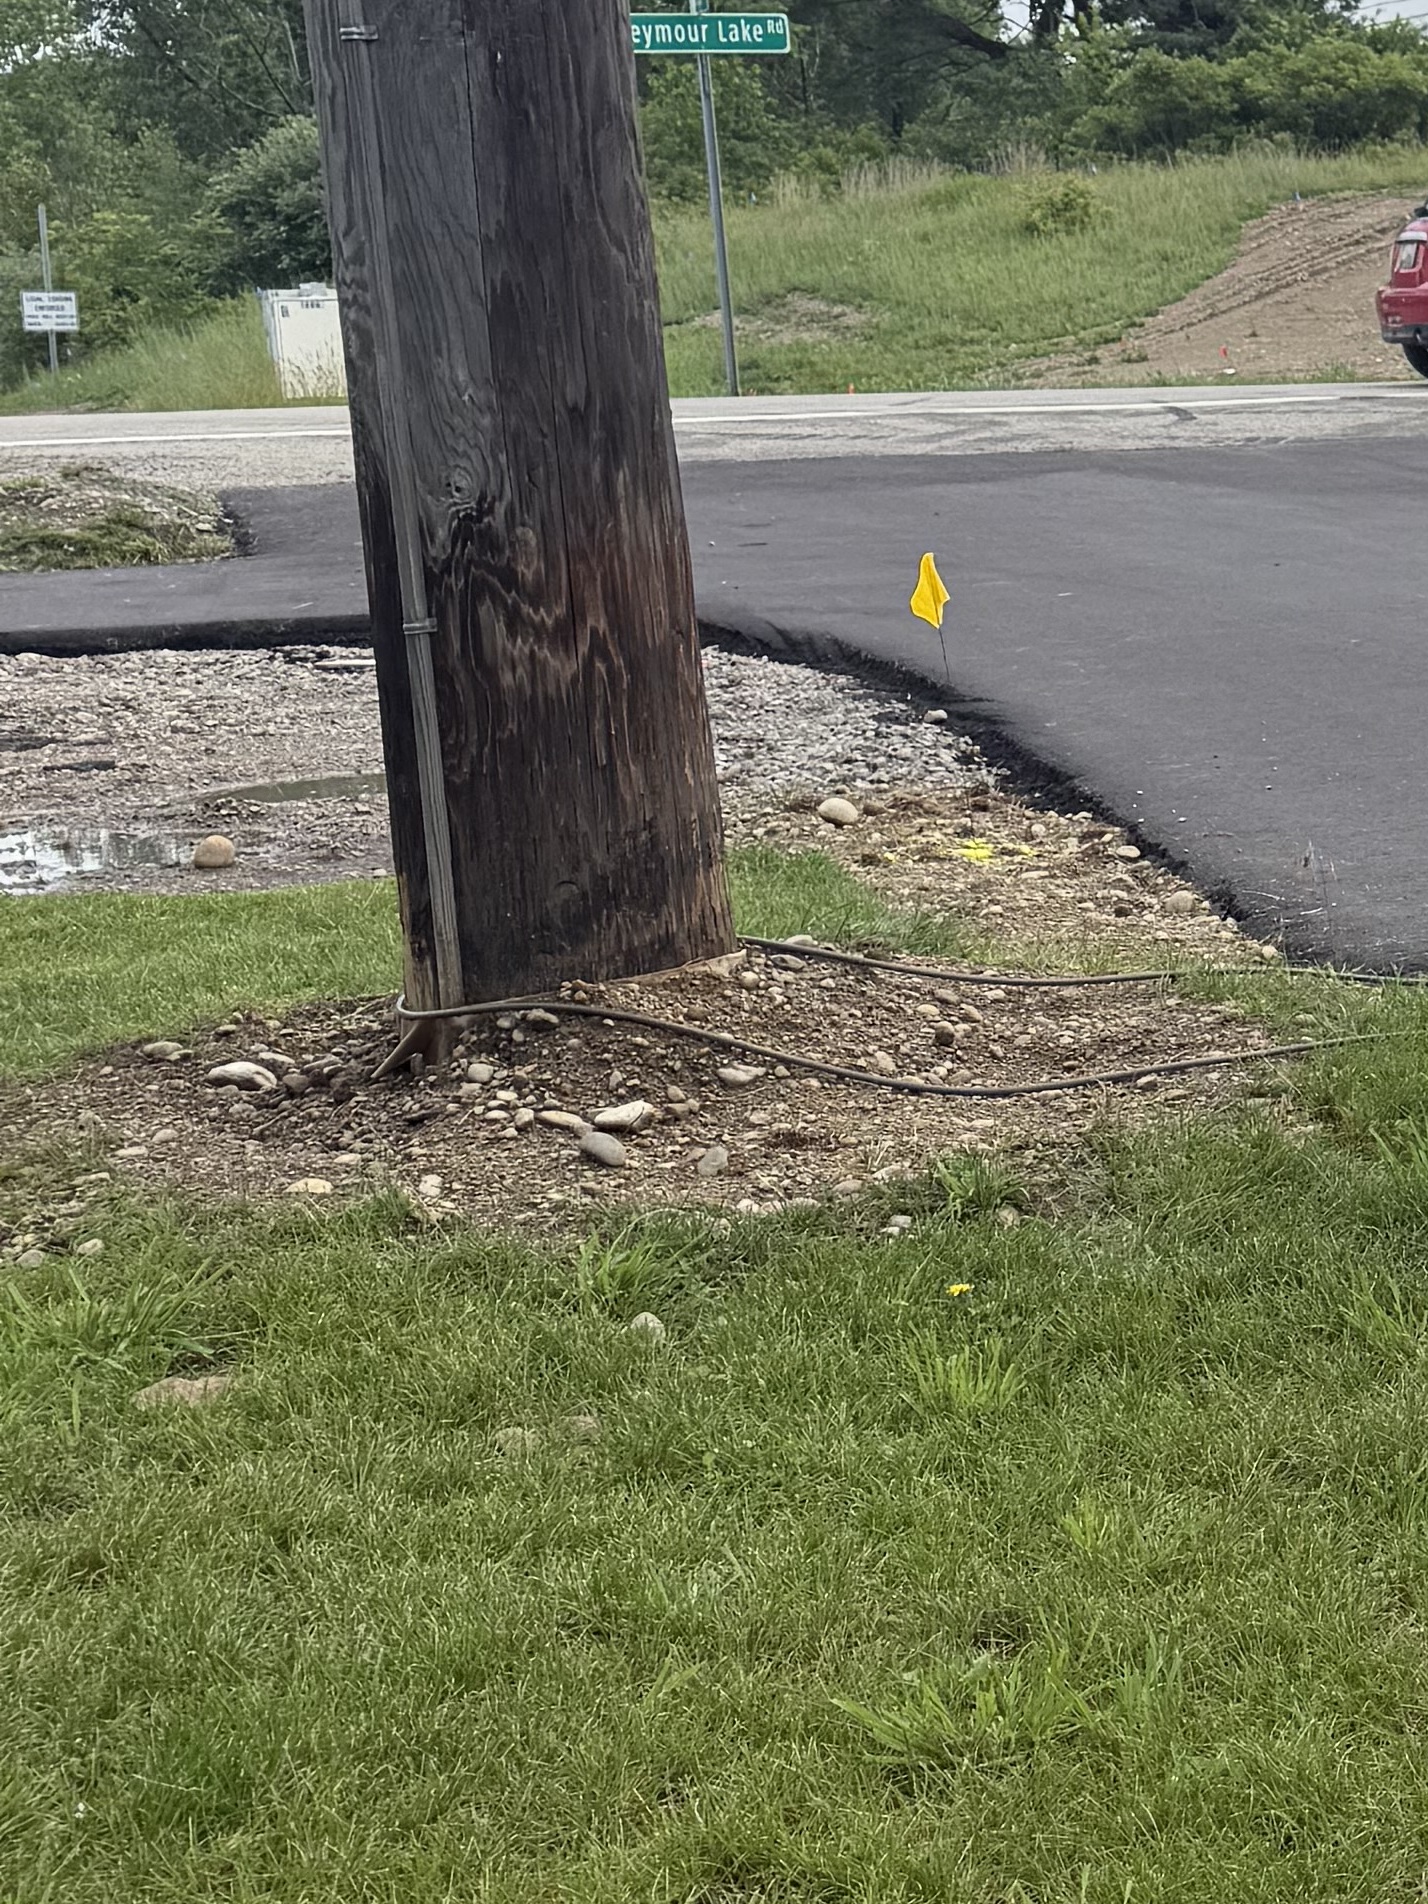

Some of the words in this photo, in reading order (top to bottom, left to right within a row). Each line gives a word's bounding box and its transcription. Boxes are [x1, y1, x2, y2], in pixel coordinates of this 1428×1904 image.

[630, 23, 709, 49] eymour
[718, 19, 763, 43] Lake
[767, 18, 784, 34] Rd
